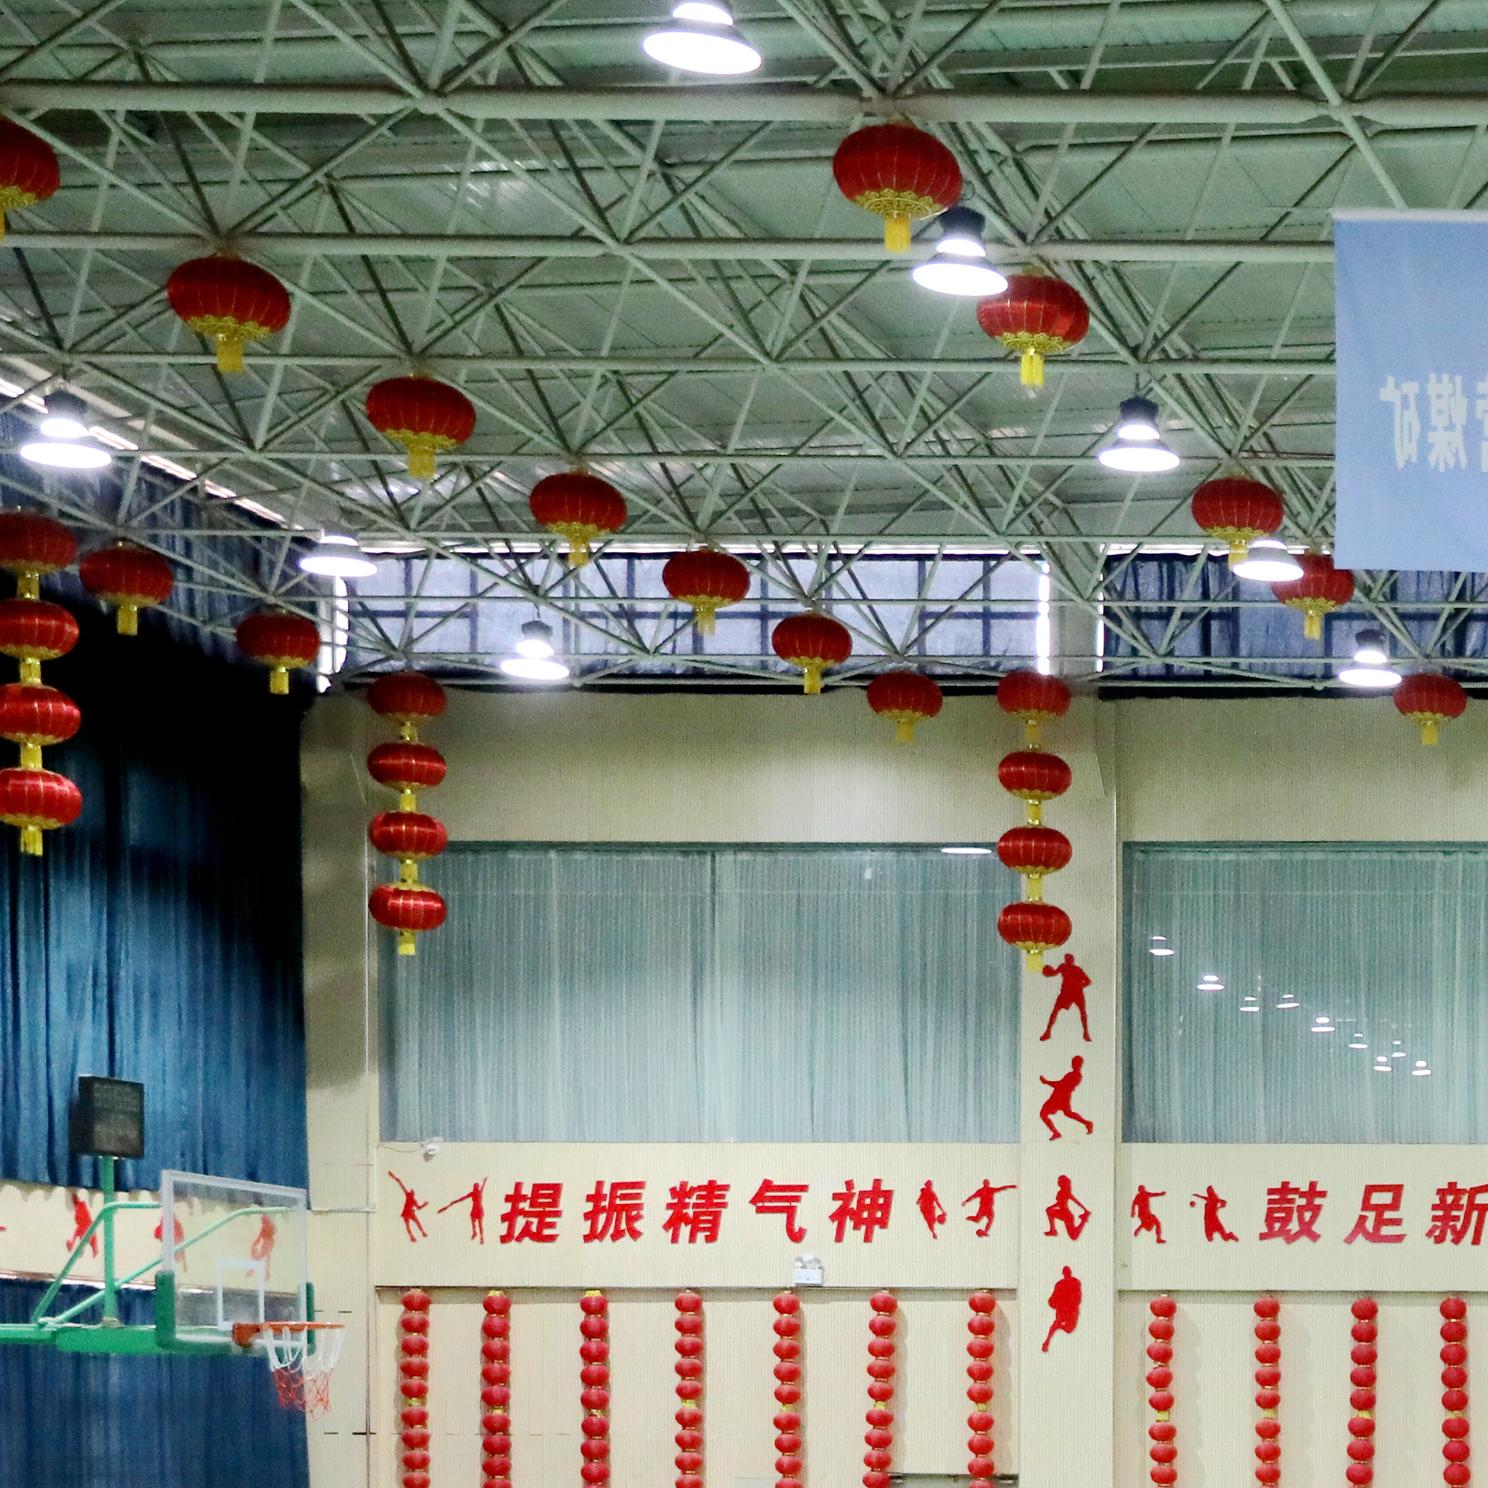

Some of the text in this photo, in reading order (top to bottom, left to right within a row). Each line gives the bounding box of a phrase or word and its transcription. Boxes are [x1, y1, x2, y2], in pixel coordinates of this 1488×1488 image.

[499, 1178, 895, 1245] 提振精气神
